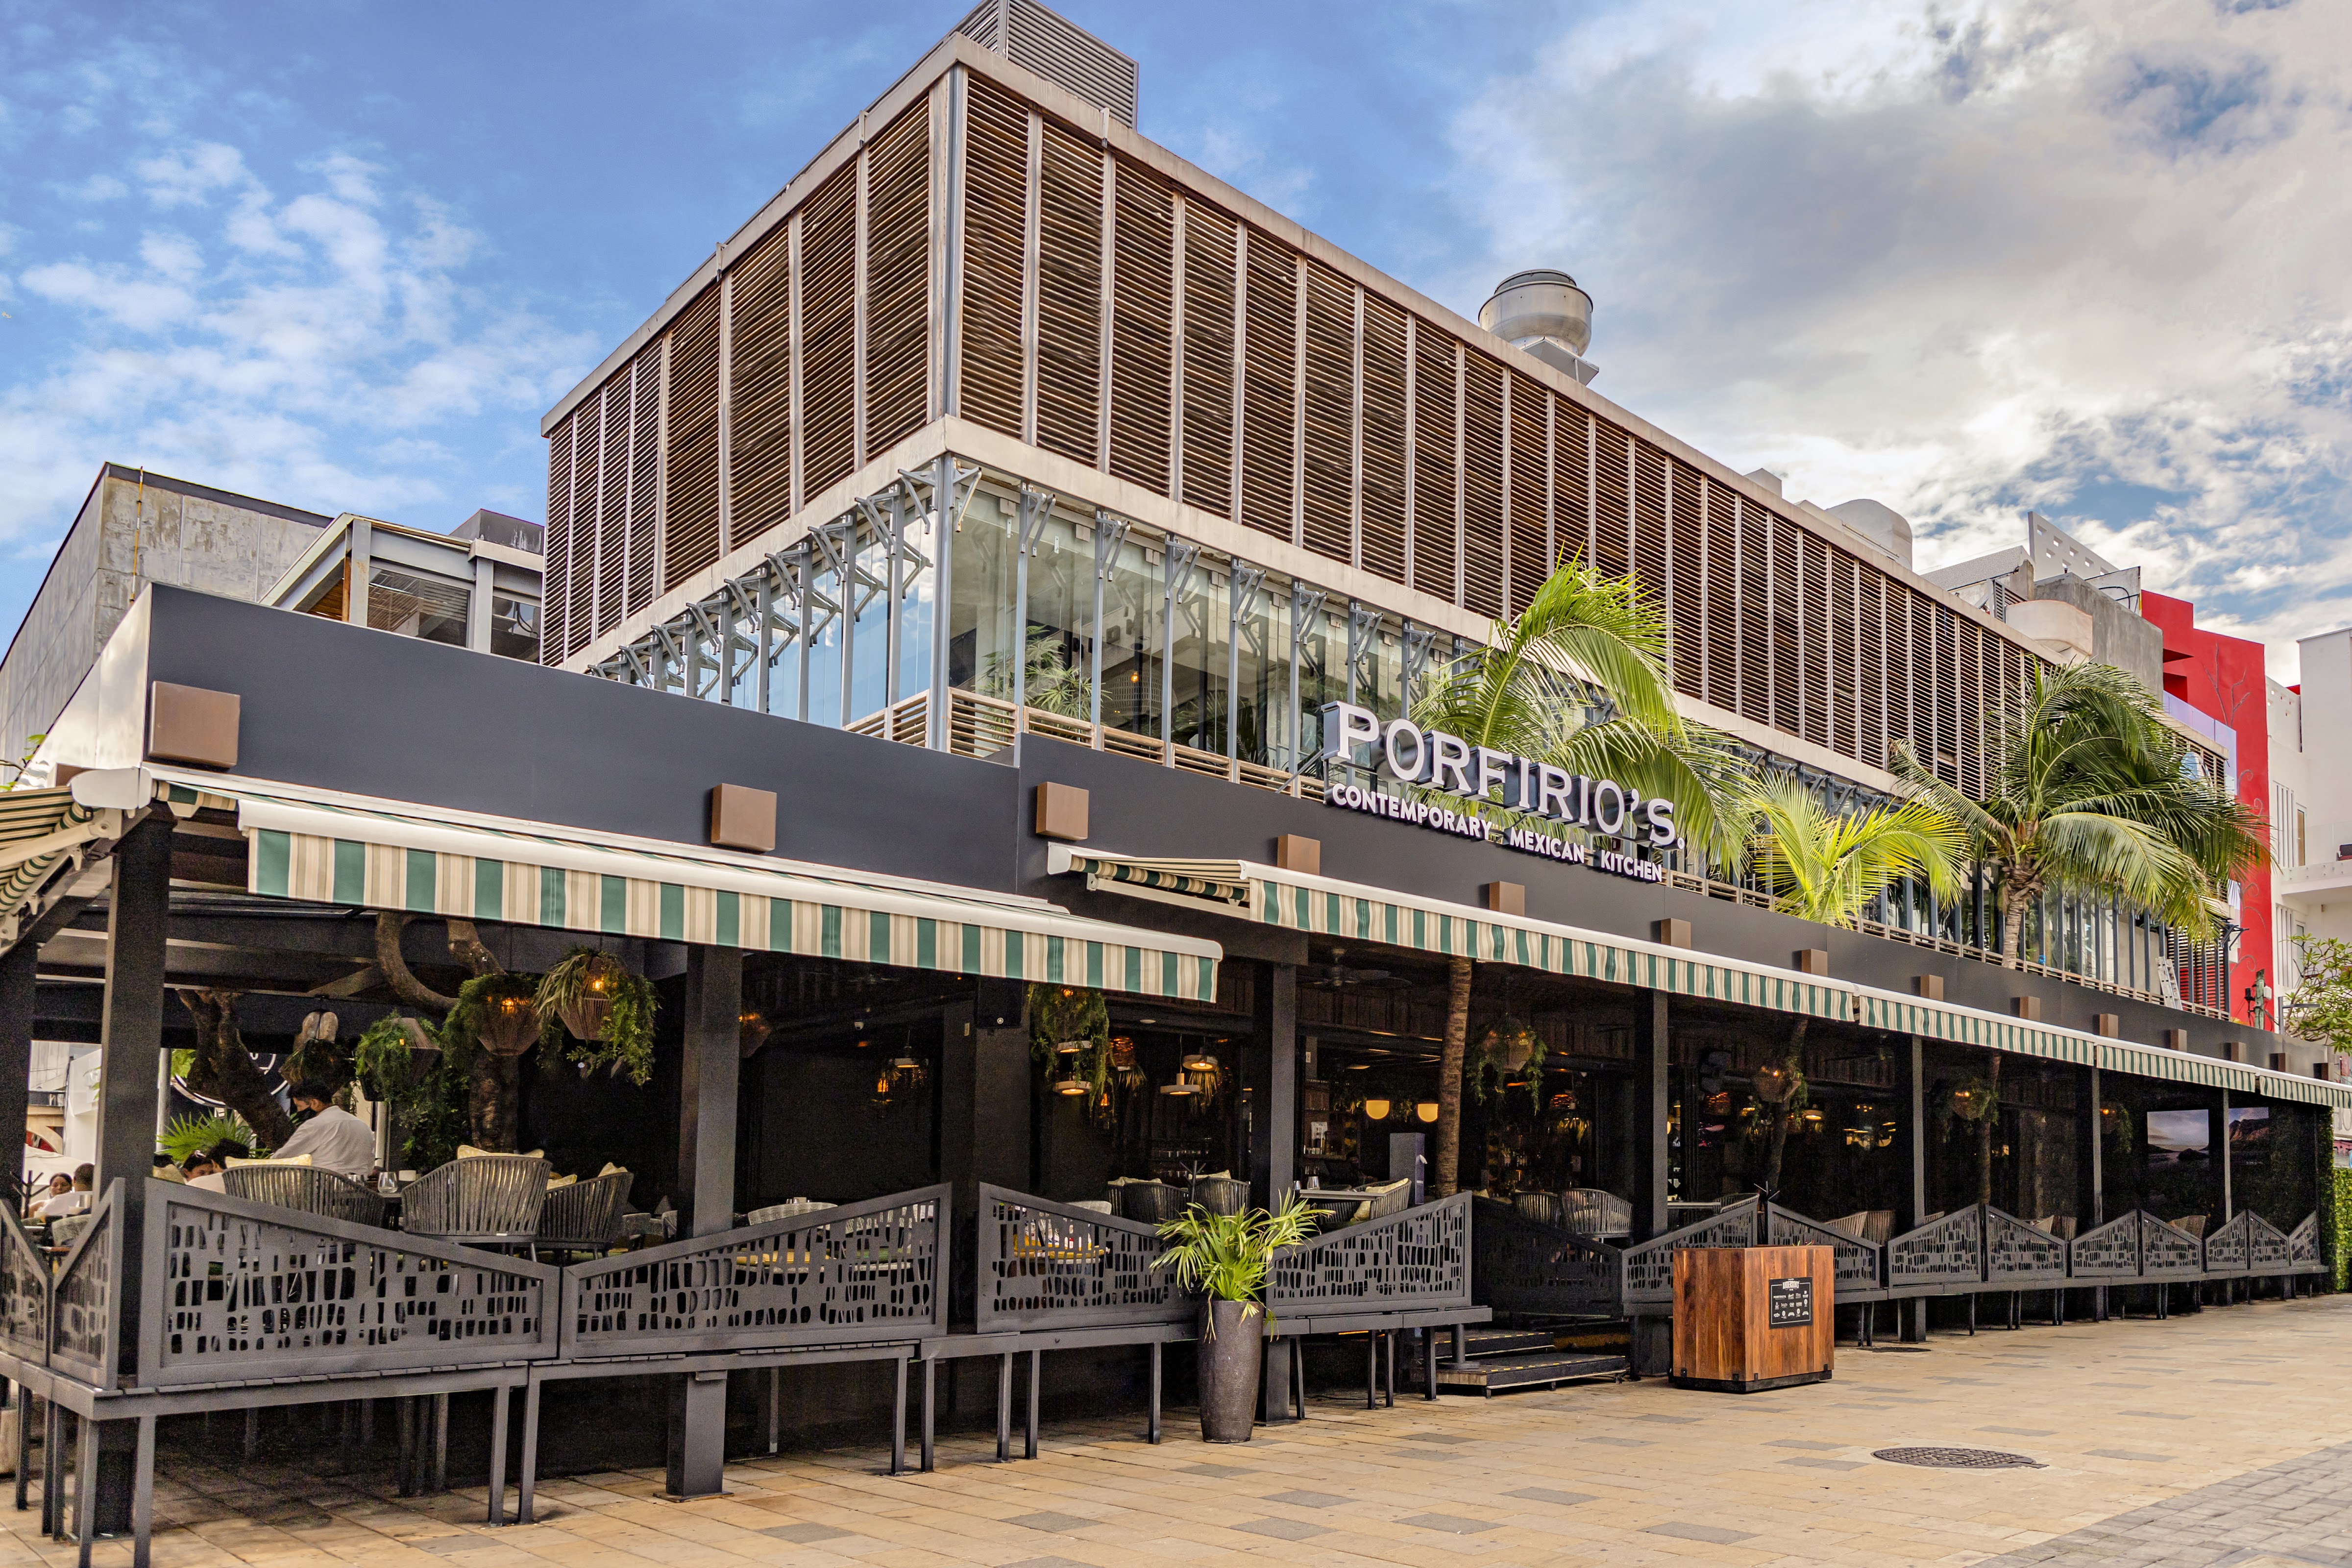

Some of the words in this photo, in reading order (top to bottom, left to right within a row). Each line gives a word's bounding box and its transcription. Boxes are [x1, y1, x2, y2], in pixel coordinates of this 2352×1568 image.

[1332, 783, 1492, 840] CONTEMPORARY
[1510, 826, 1584, 863] MEXICAN
[1600, 849, 1662, 882] KITCHEN
[1337, 700, 1675, 846] PORFIRIO'S
